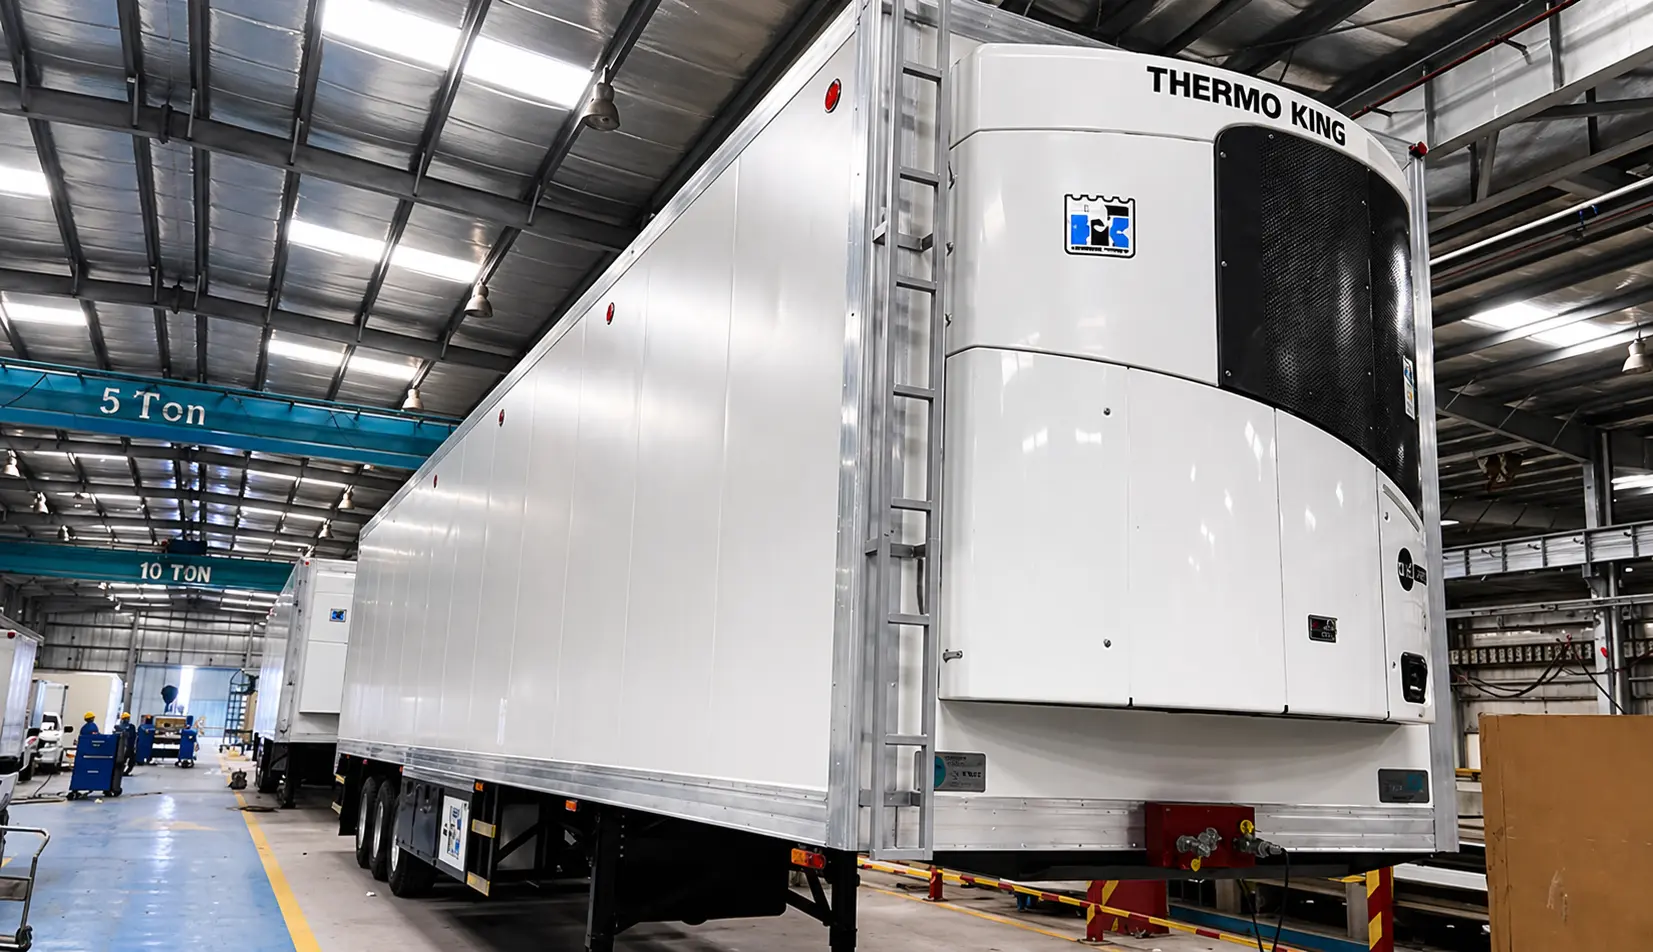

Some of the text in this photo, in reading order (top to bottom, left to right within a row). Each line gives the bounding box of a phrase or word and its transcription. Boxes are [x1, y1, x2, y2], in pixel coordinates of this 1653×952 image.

[1147, 65, 1346, 146] THERMO KING
[100, 387, 206, 425] 5 Ton
[140, 562, 212, 583] 10 TON
